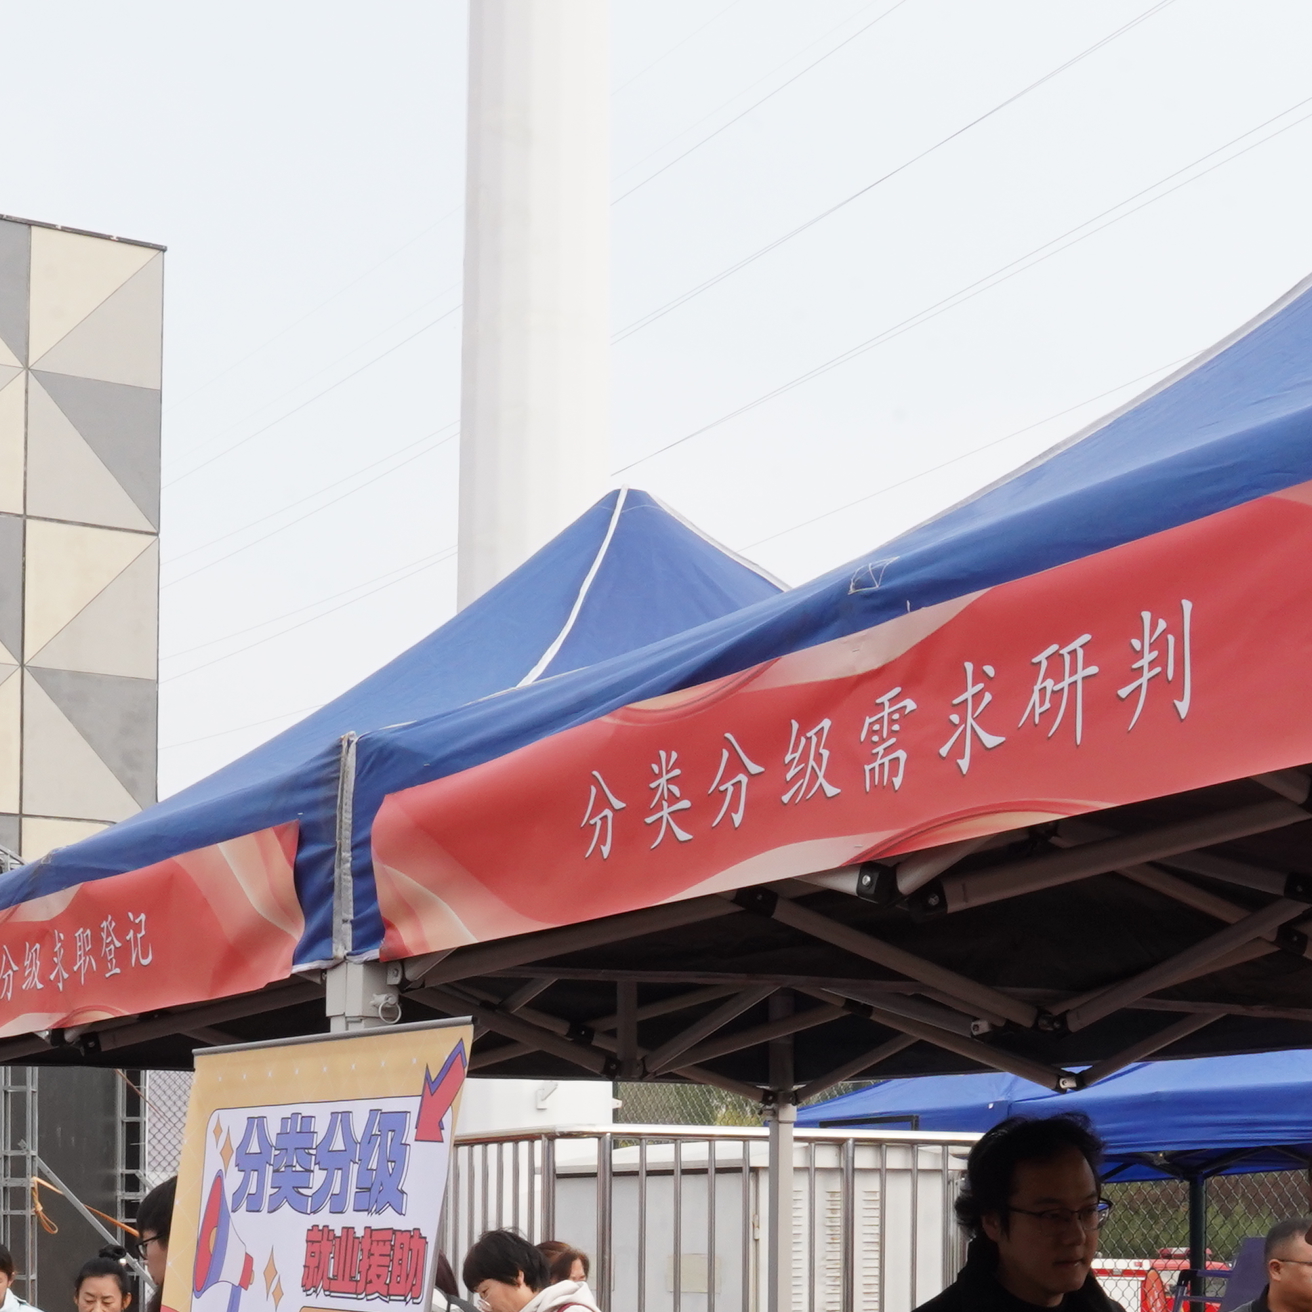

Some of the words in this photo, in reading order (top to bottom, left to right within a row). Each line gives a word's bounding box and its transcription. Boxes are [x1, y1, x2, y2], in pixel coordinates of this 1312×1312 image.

[580, 598, 1193, 860] 分类分级需求研判
[231, 1109, 412, 1215] 分类分级
[301, 1224, 429, 1305] 就业援助
